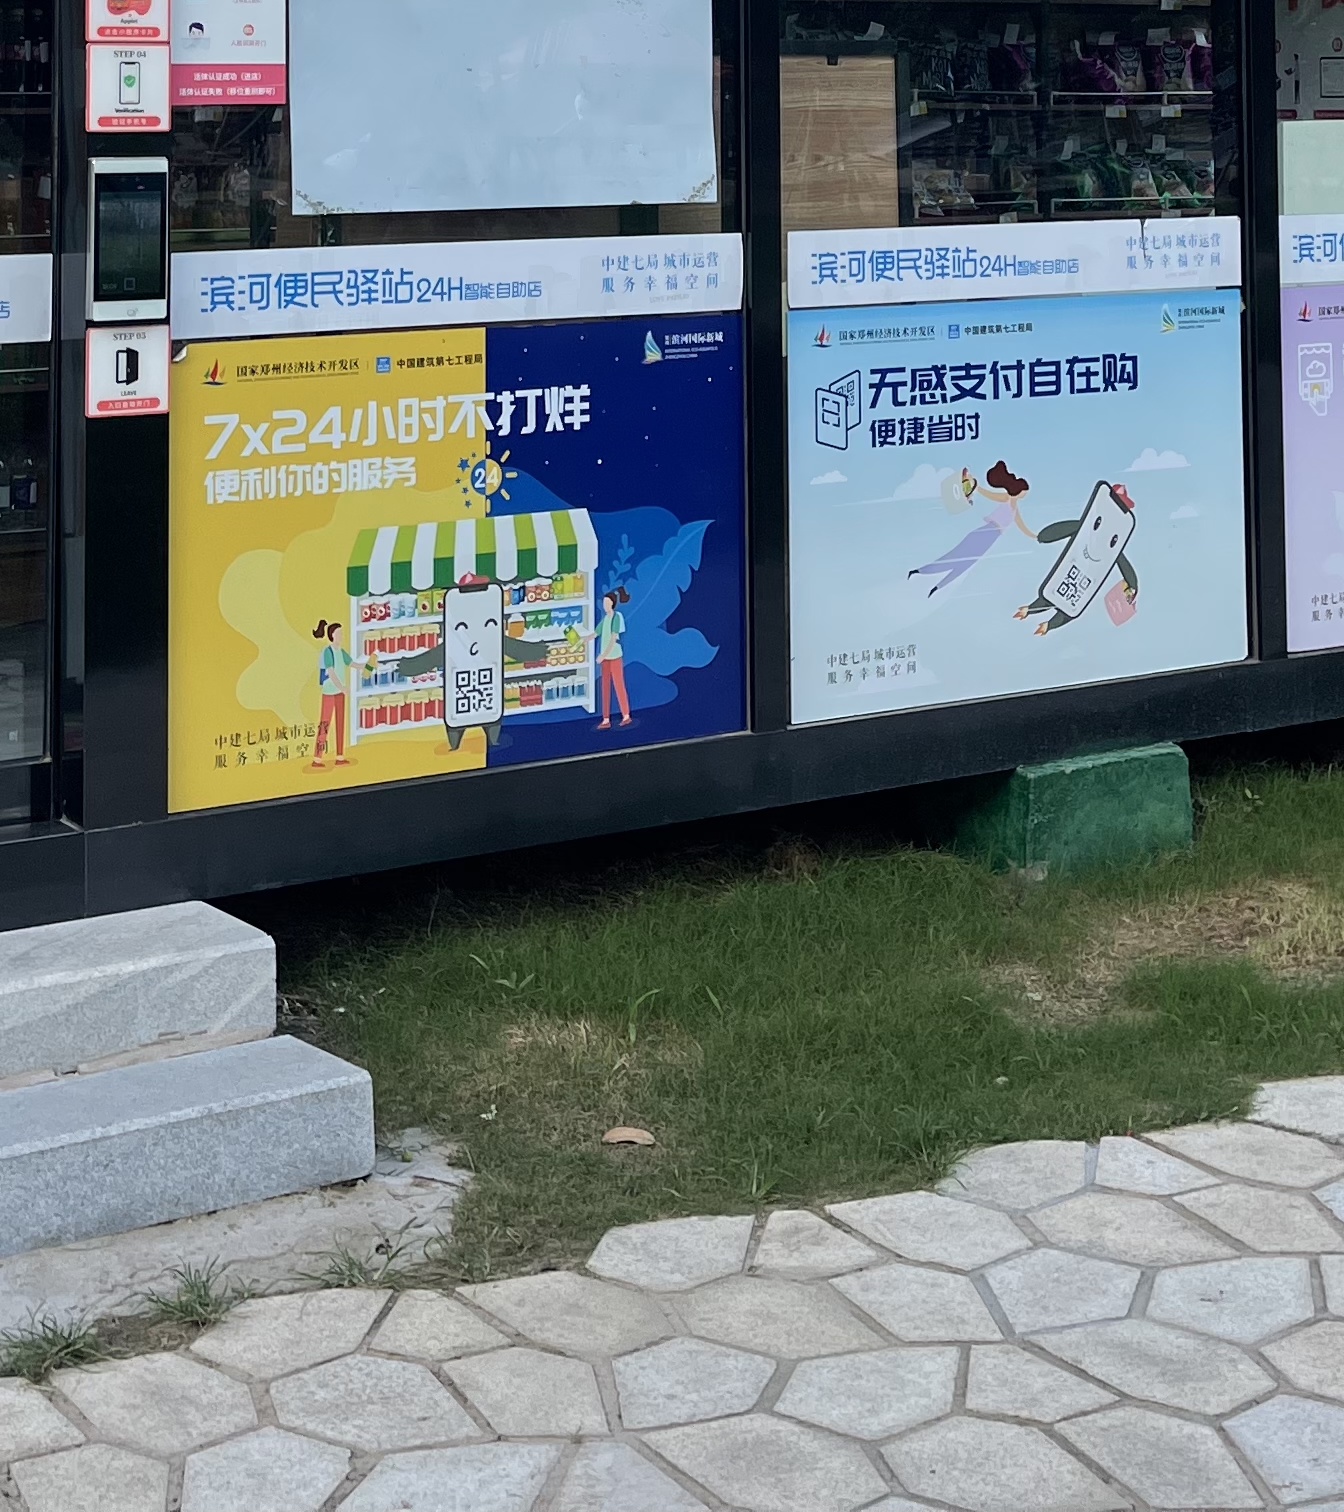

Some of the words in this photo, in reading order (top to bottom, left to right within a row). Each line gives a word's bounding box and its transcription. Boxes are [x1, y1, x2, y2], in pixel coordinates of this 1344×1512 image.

[113, 50, 135, 58] STEP
[136, 50, 147, 58] 04
[1125, 251, 1222, 271] 服务幸福空间
[600, 272, 719, 294] 服务幸福空间
[112, 332, 135, 341] STEP
[838, 325, 936, 342] 国家郑州经济技术开发区
[236, 357, 360, 378] 国家郑州经济技术开发区
[396, 353, 483, 370] 中国建筑第七工程局
[868, 352, 1139, 410] 无感支付自在购
[869, 411, 981, 449] 便捷省时
[204, 456, 417, 505] 便利你的服务
[474, 466, 500, 489] 24
[826, 660, 918, 686] 服务幸福空间
[213, 739, 330, 770] 服务幸福空间
